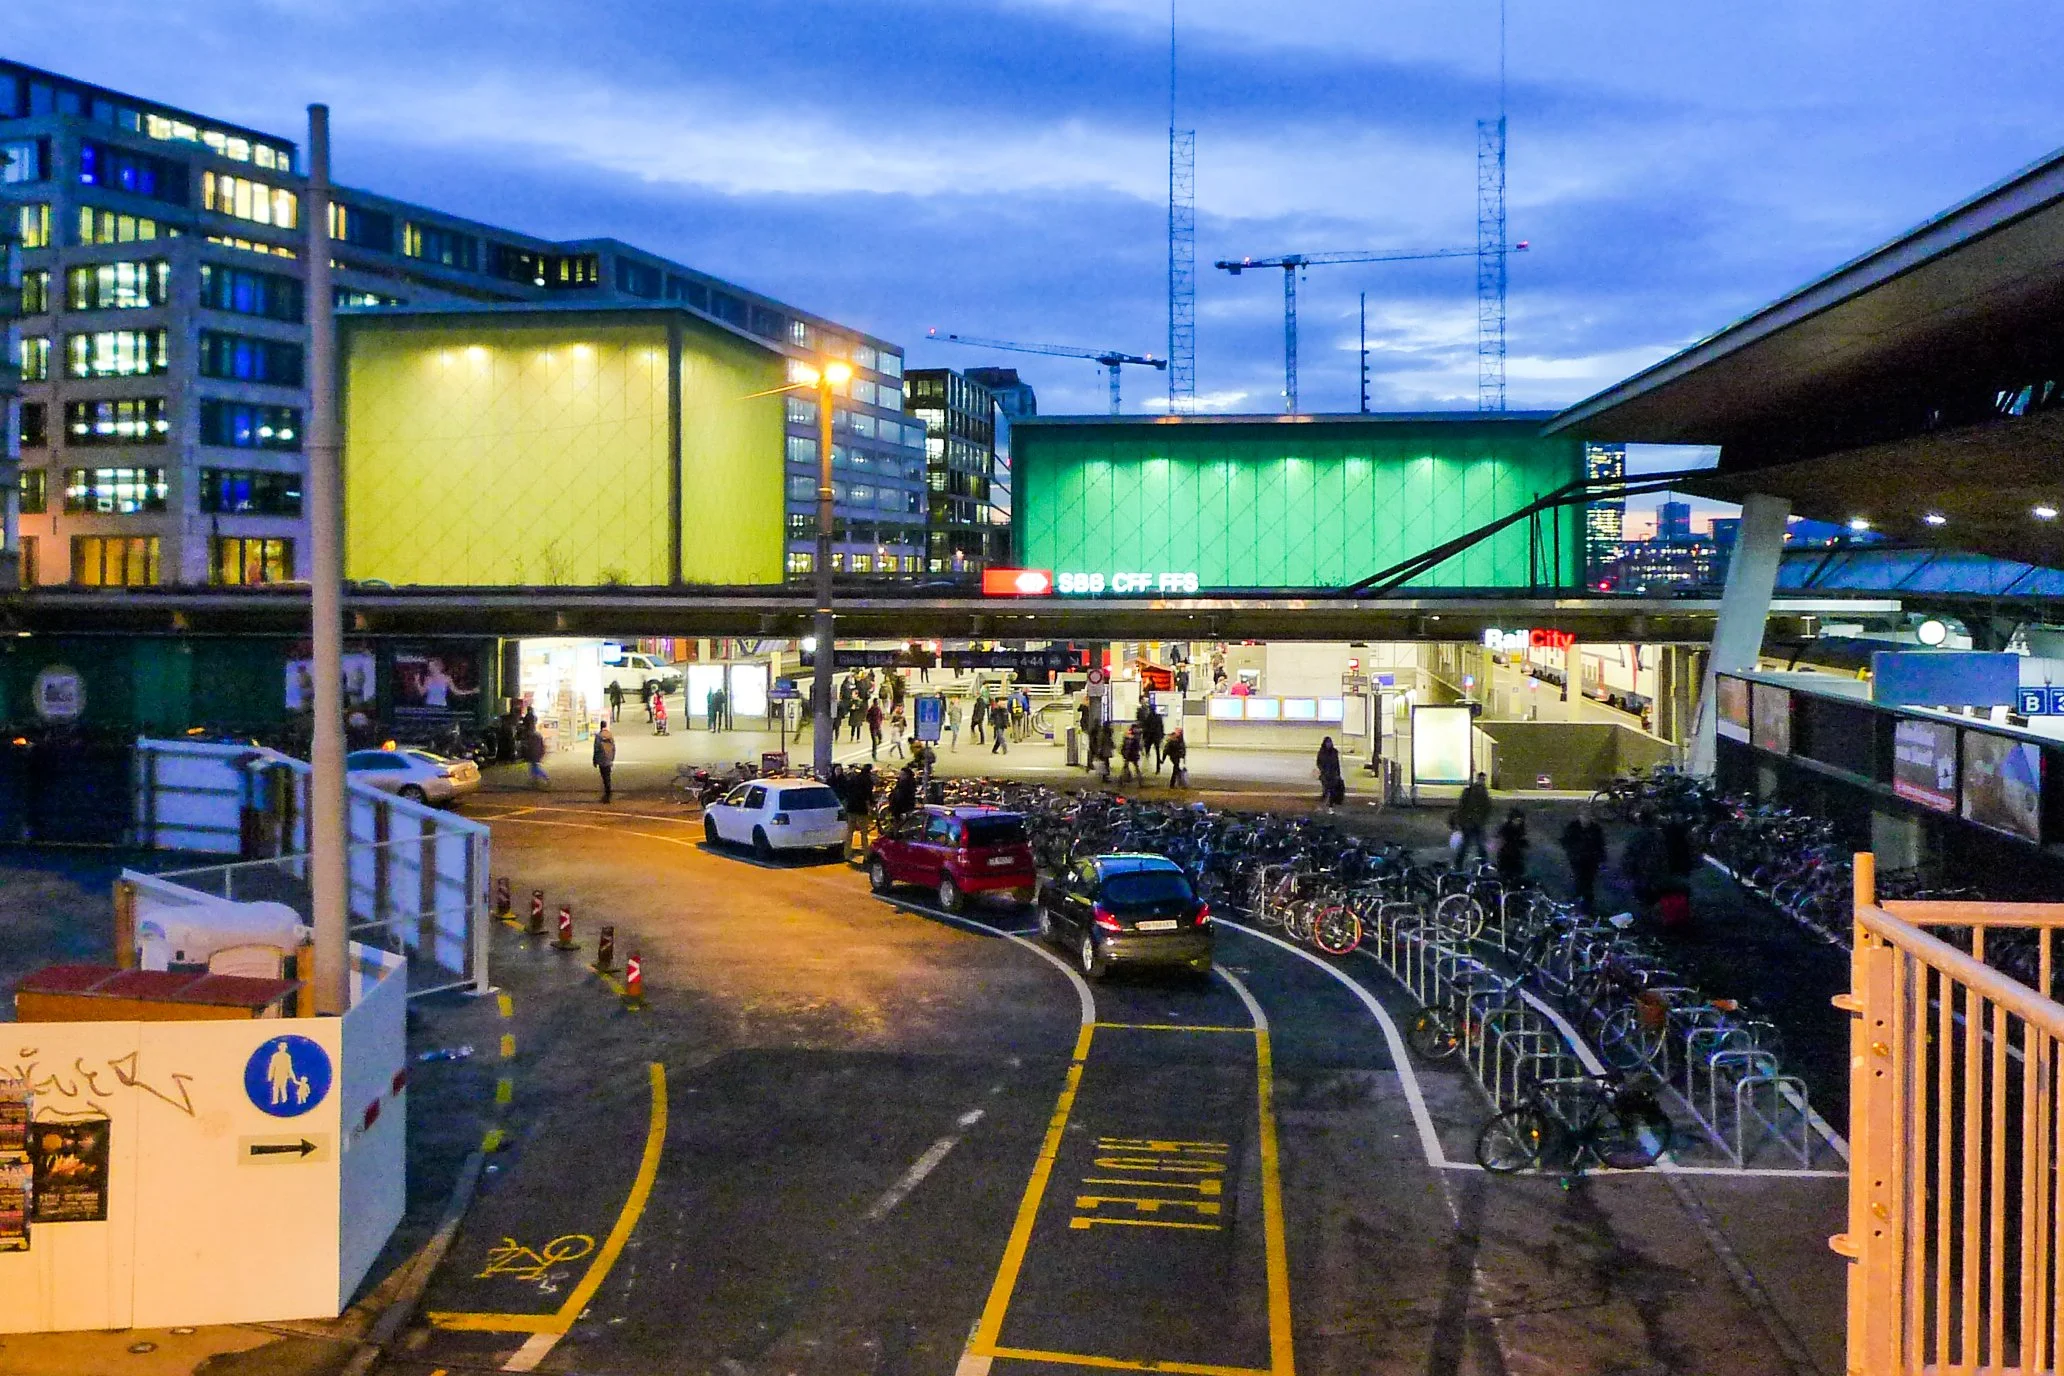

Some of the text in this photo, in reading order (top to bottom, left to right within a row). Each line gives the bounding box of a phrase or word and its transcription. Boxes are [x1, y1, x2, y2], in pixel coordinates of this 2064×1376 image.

[1058, 572, 1199, 593] SBB CFF FFS
[1484, 628, 1575, 654] RailCity
[2026, 696, 2040, 712] B
